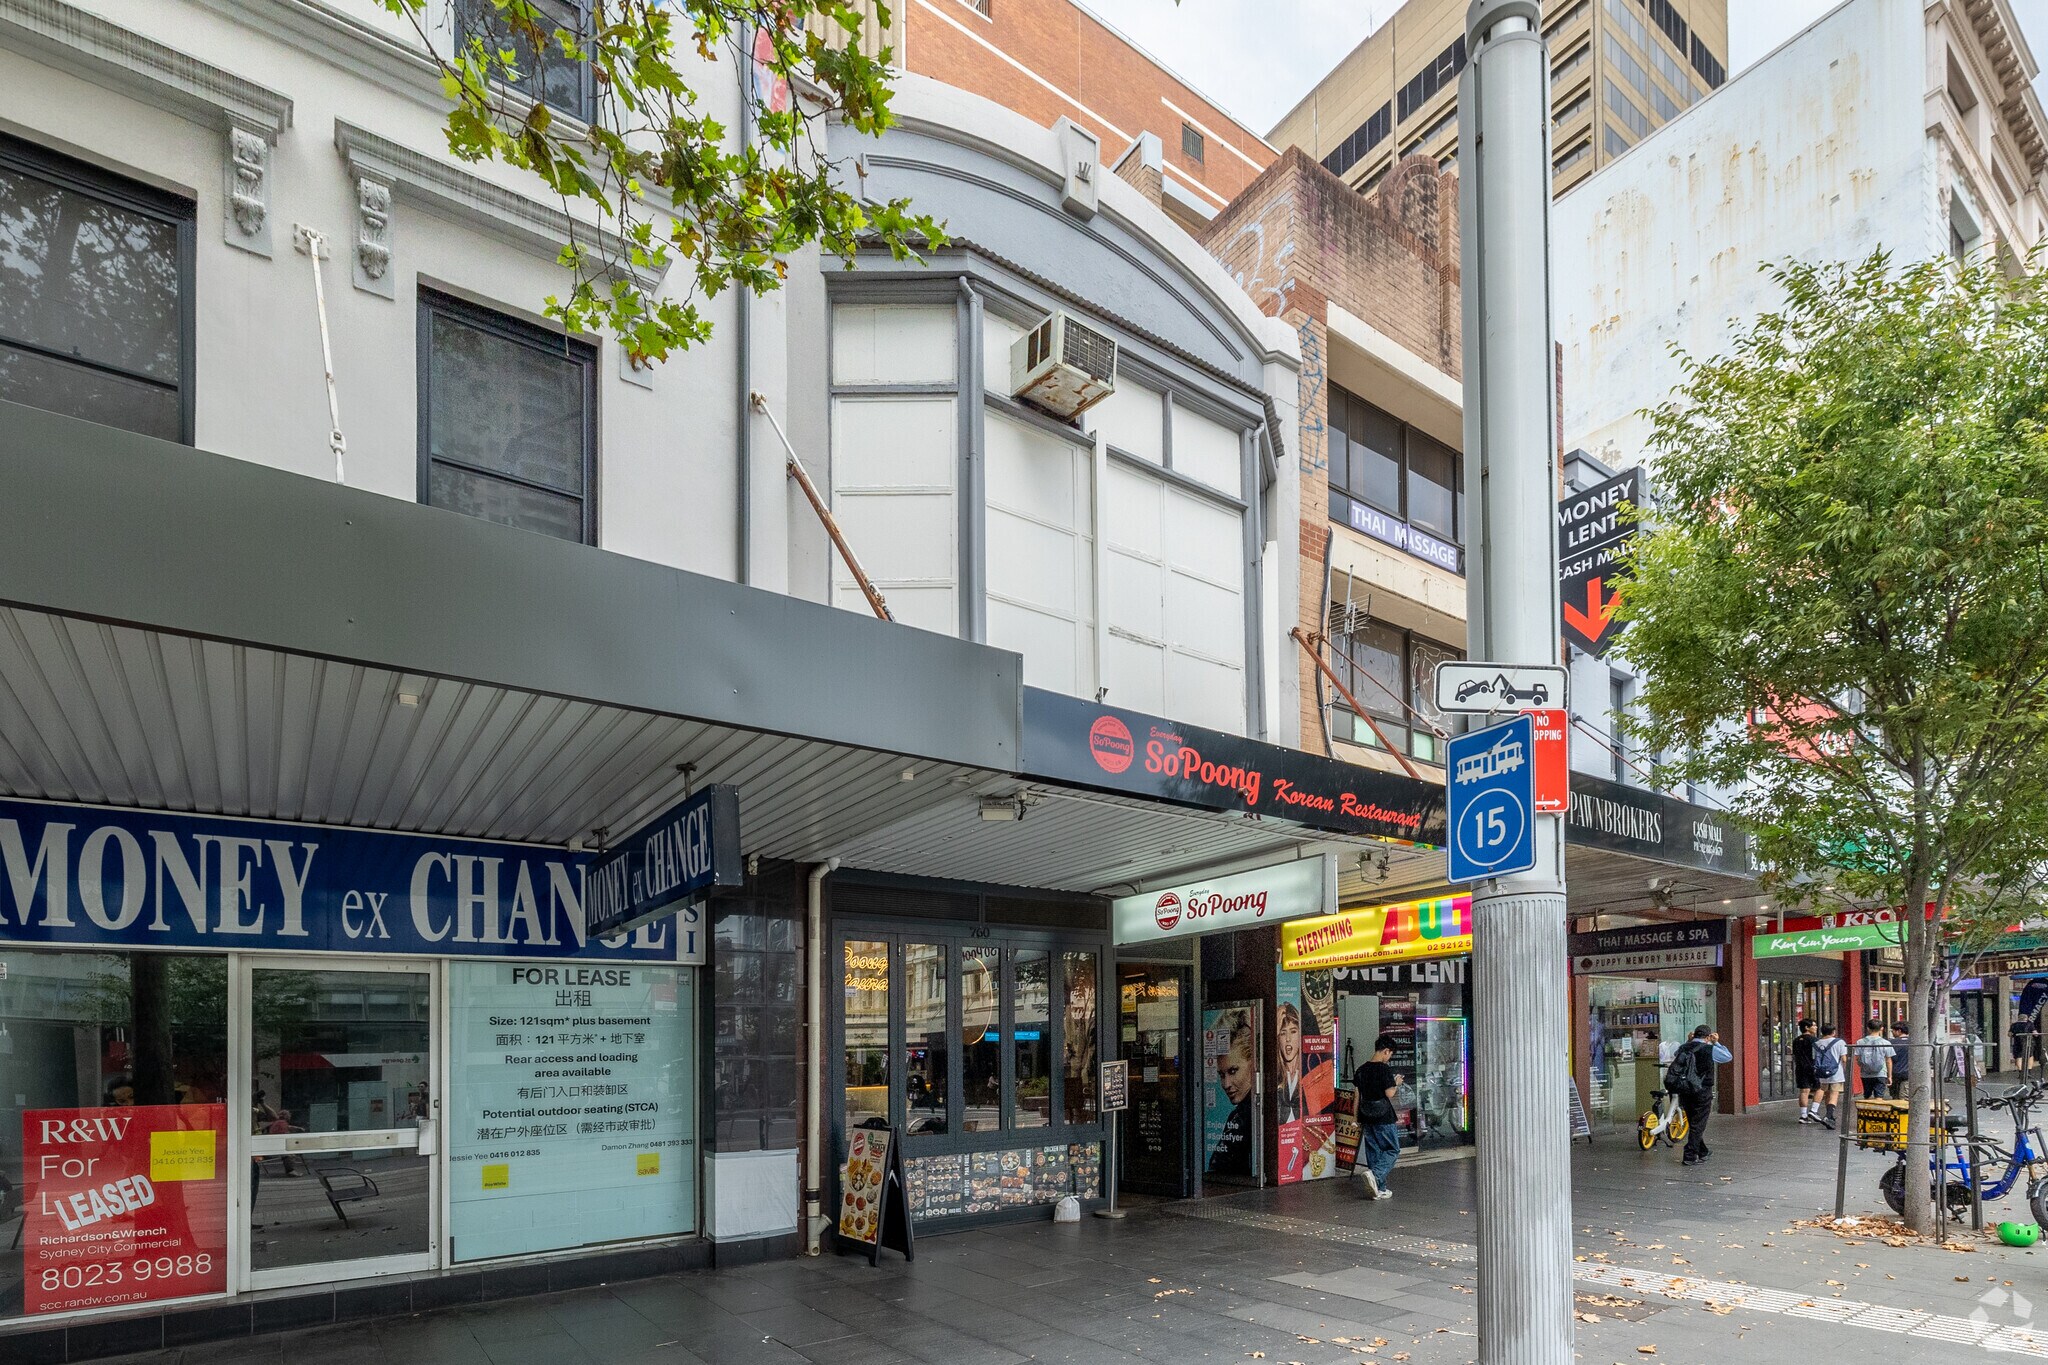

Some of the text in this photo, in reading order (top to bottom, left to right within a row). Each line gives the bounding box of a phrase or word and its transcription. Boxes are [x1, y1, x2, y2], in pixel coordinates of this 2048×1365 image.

[1558, 479, 1633, 527] MONEY
[1352, 505, 1455, 566] THAI MASSAGE
[1569, 511, 1618, 548] LENT
[1536, 715, 1550, 727] NO
[1149, 726, 1183, 744] Everyday
[1534, 729, 1562, 741] OPPING
[1093, 735, 1130, 755] SoPoong
[1145, 740, 1422, 827] SoPoong Korean Restaurant
[1569, 791, 1662, 844] PAWNBROKERS
[1476, 805, 1506, 849] 15
[1708, 824, 1724, 843] MALL
[588, 802, 711, 928] MONEY ex CHANGE
[0, 818, 665, 950] MONEY ex CHAN
[1189, 888, 1210, 898] Everyday
[1157, 906, 1179, 916] SoPoong
[1187, 890, 1268, 919] SoPoong
[1843, 909, 1891, 927] KFC
[969, 927, 990, 938] 760
[1296, 918, 1353, 956] EVERYTHING
[1598, 928, 1709, 948] THAI MASSAGE & SPA
[1427, 943, 1439, 952] 02
[1441, 940, 1463, 950] 9212
[1822, 934, 1872, 950] Young
[1287, 948, 1404, 968] www.everythingadult.com.au
[1595, 951, 1708, 967] PUPPY MEMORY MASSAGE
[512, 968, 631, 987] FOR LEASE
[1332, 959, 1467, 984] ONEY LENT
[555, 990, 592, 1007] 出租
[489, 1016, 517, 1026] Size:
[572, 1016, 596, 1027] plus
[598, 1015, 651, 1026] basement
[535, 1035, 554, 1044] 121
[610, 1032, 645, 1044] 地下室
[505, 1053, 638, 1064] Rear access and loading
[534, 1068, 611, 1078] area available
[517, 1084, 628, 1100] 有后门入口和装卸区
[482, 1102, 659, 1119] Potential outdoor seating (STCA)
[39, 1117, 132, 1145] R&W
[1207, 1121, 1239, 1131] Enjoy the
[628, 1142, 649, 1150] Zhang
[1207, 1132, 1243, 1143] #Satisfyer
[162, 1148, 188, 1156] Jessie
[1207, 1143, 1228, 1153] Effect
[41, 1154, 99, 1179] For
[153, 1157, 175, 1166] 0416
[638, 1166, 659, 1176] savills
[54, 1174, 155, 1232] LEASED
[40, 1226, 167, 1246] Richardson&Wrench
[40, 1237, 182, 1261] Sydney City Commercial
[41, 1253, 212, 1291] 8023 9988
[40, 1291, 148, 1311] scc.randw.com.au
